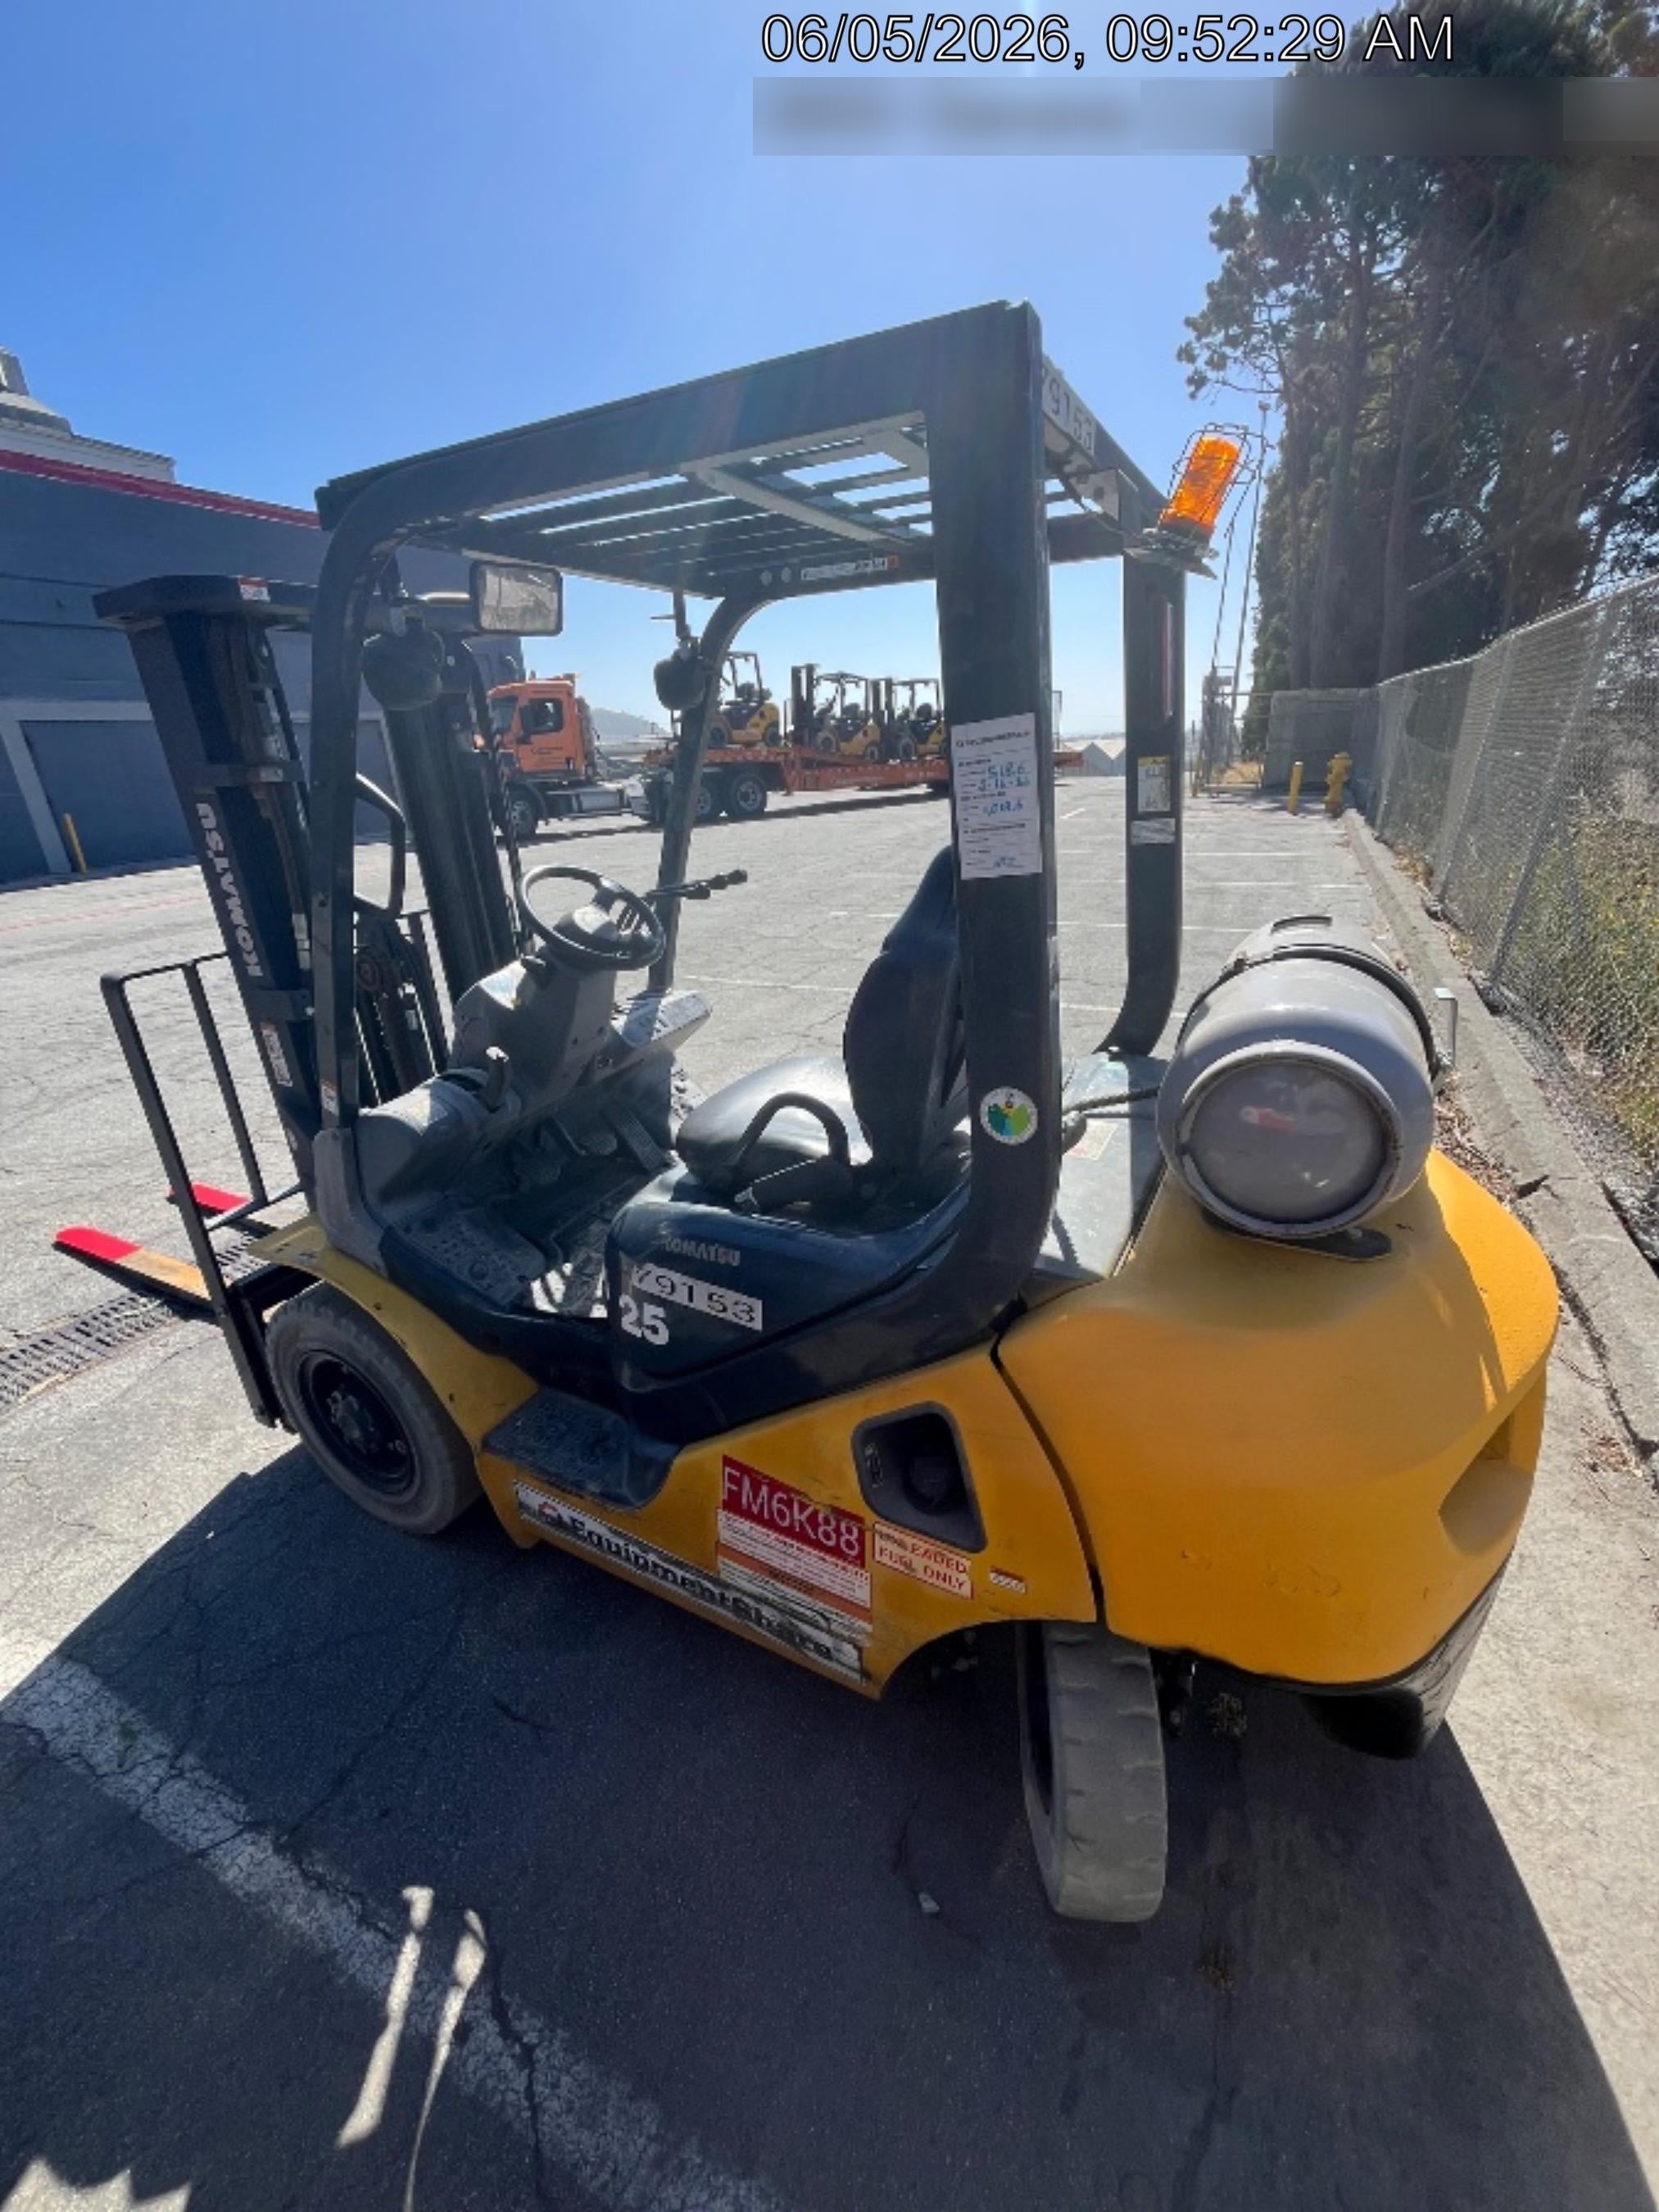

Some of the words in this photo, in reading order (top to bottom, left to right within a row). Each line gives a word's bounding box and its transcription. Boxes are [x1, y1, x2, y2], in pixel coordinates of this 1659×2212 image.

[1043, 369, 1093, 451] 9153
[196, 802, 264, 977] KOMATSU
[664, 1235, 741, 1267] KOMATSU
[619, 1294, 669, 1345] 25
[636, 1269, 755, 1323] 79153
[723, 1465, 860, 1557] FM6K88
[922, 1566, 965, 1591] ONLY
